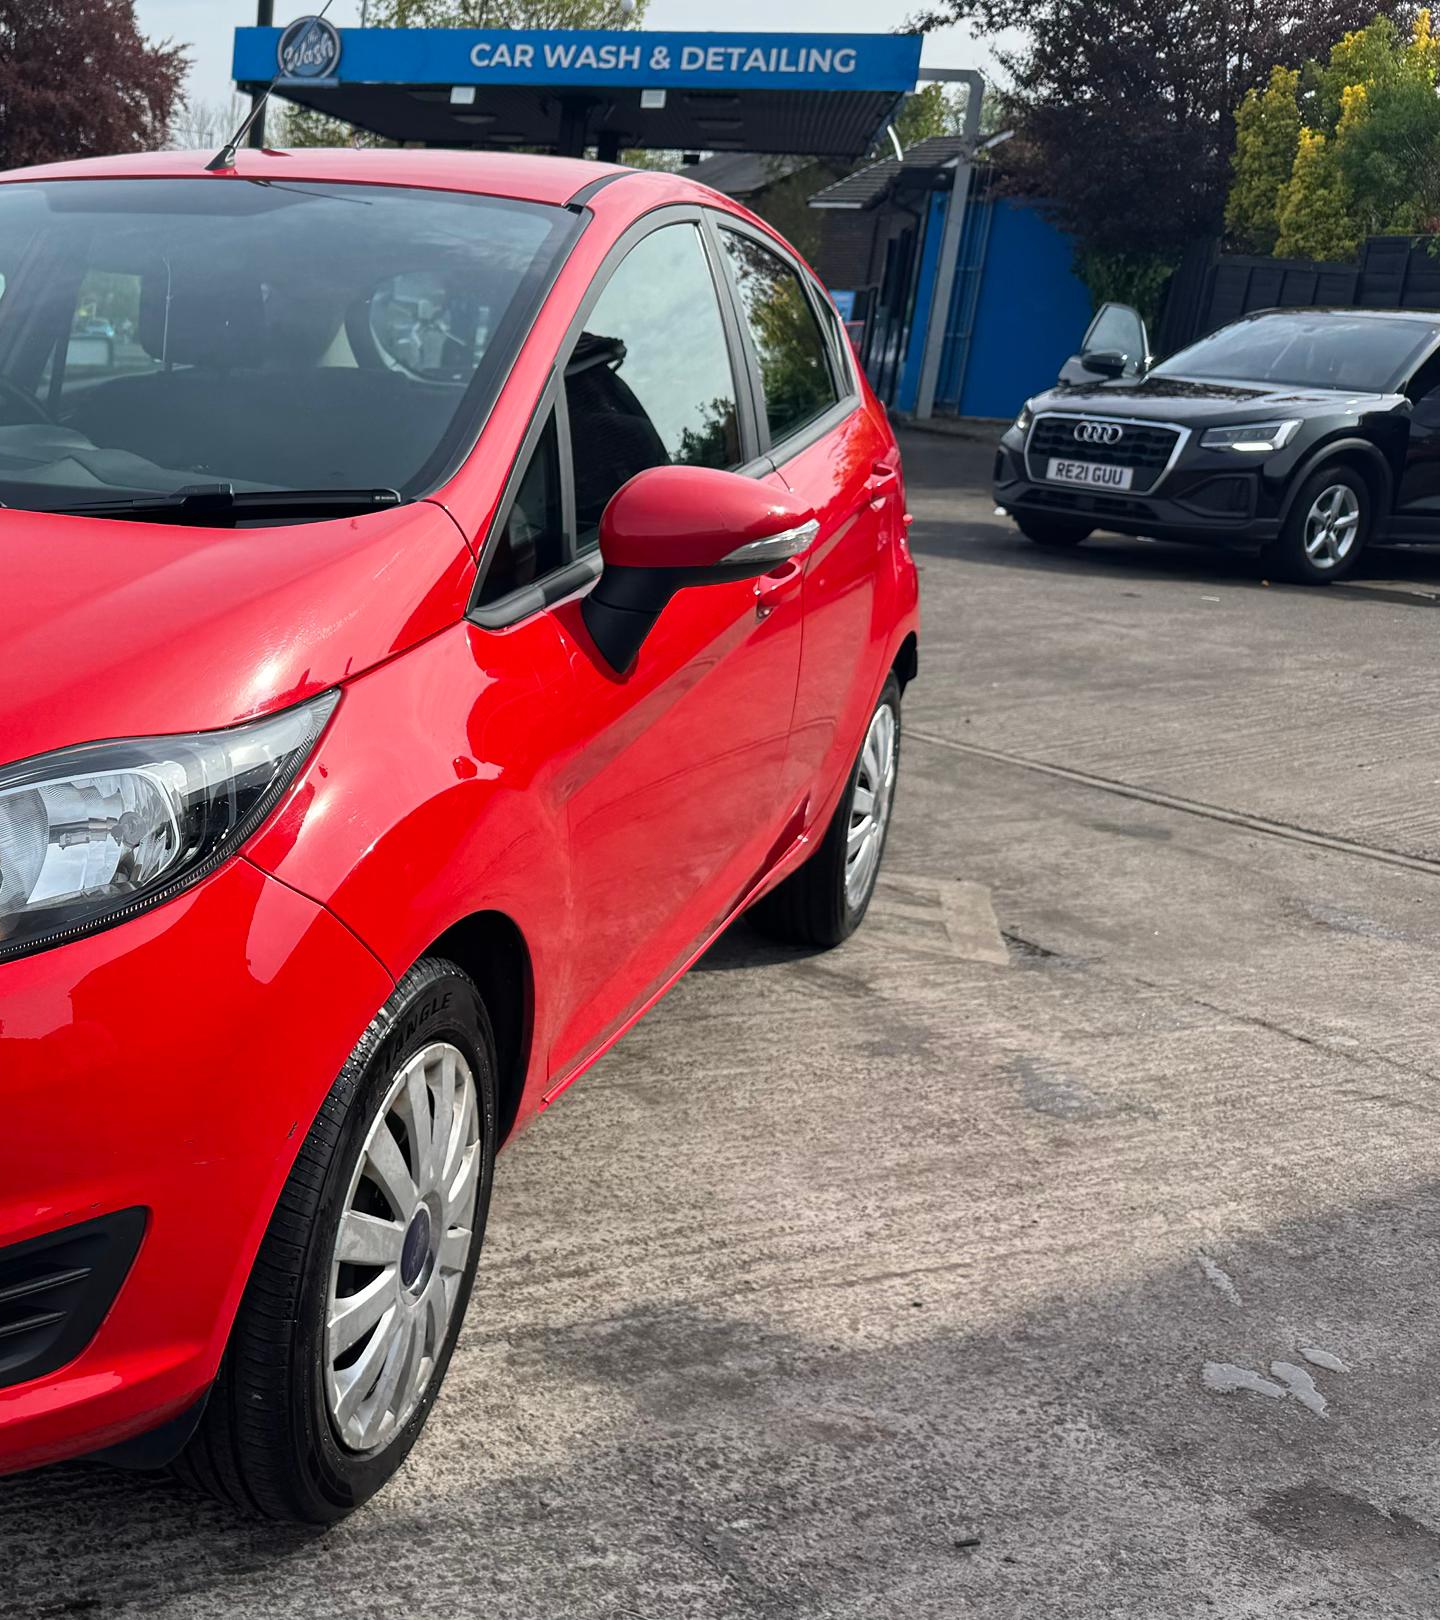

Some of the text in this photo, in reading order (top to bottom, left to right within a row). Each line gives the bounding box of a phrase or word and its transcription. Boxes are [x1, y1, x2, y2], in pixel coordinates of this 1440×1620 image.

[284, 32, 334, 71] Wash
[470, 43, 857, 73] CAR WASH & DETAILING
[1056, 462, 1123, 485] RE21 GUU
